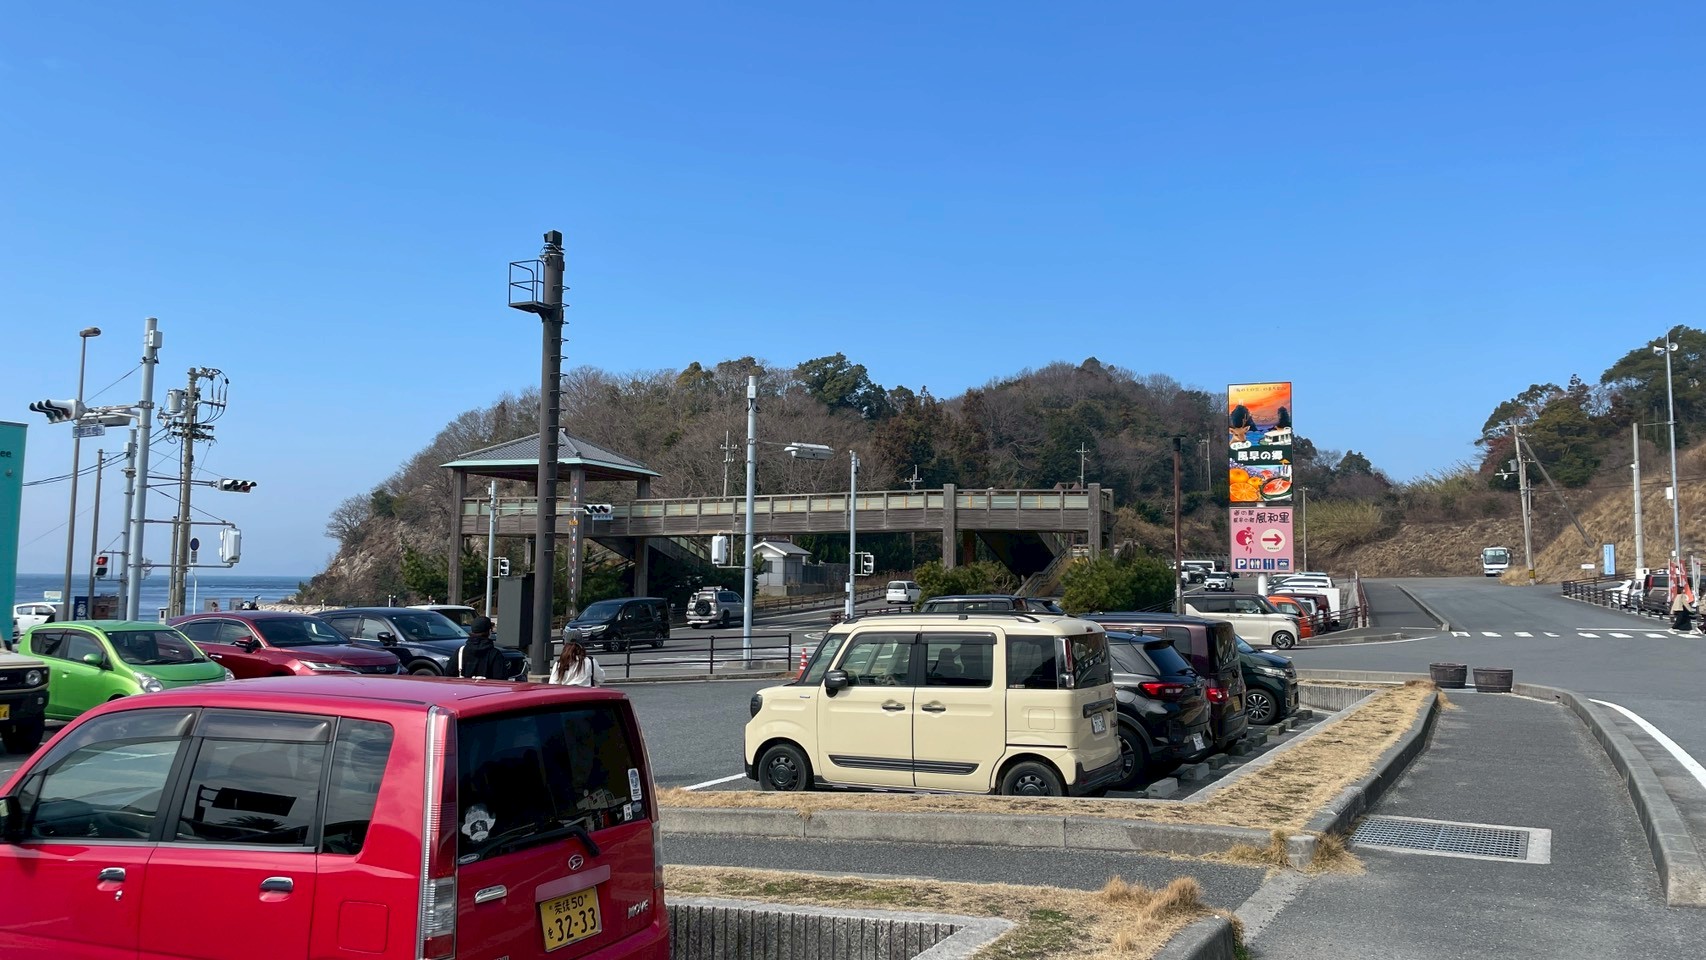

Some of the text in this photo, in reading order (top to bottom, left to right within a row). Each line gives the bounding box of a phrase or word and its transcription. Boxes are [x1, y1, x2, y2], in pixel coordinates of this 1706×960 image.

[1237, 450, 1283, 461] 風早の郷
[1255, 511, 1290, 523] 風和里
[1237, 559, 1246, 569] P
[555, 907, 597, 942] 32-33
